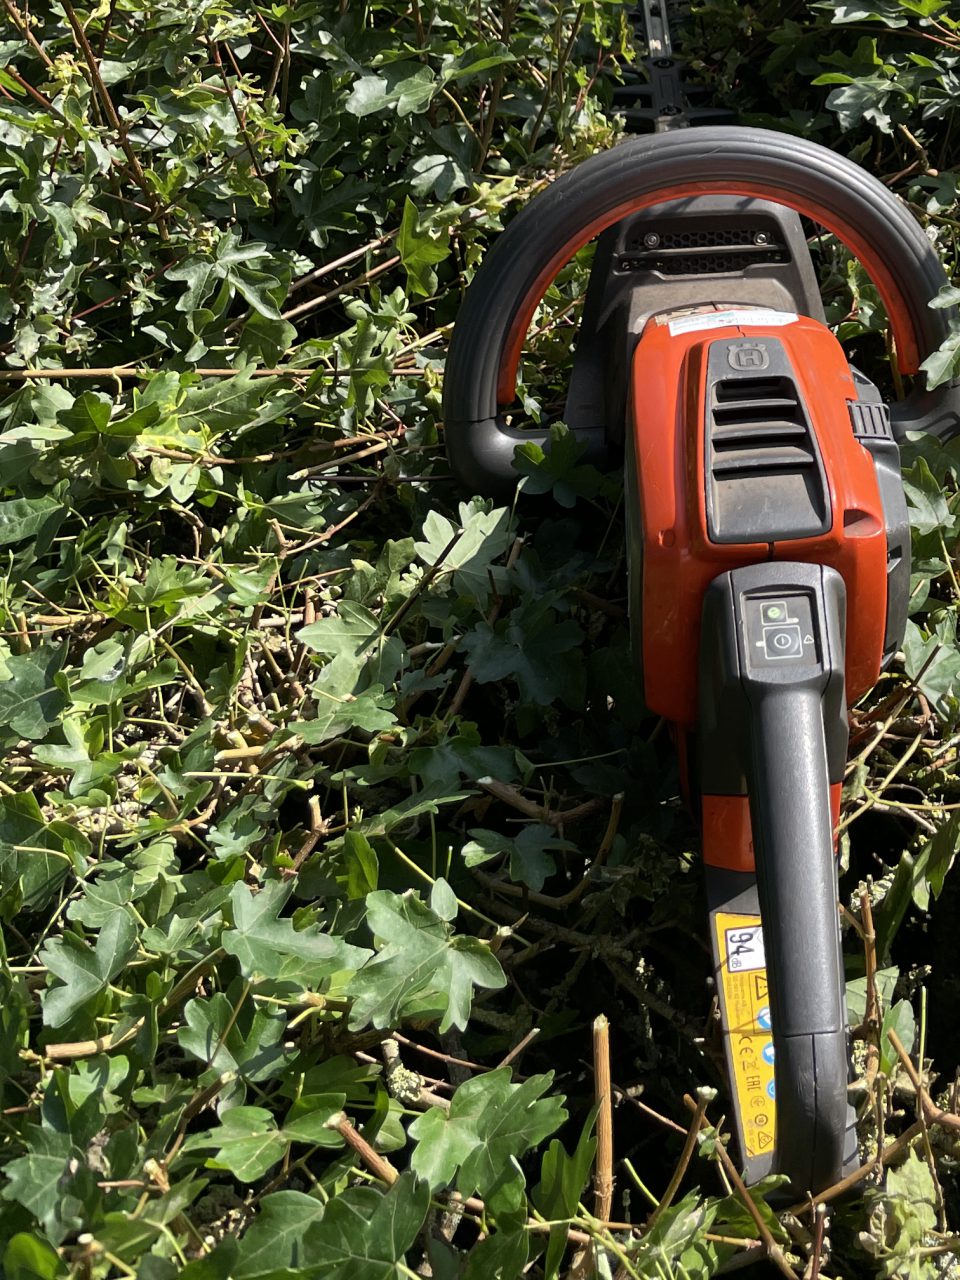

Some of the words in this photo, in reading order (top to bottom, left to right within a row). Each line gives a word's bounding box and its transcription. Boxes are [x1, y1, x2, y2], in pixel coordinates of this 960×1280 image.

[738, 350, 759, 366] H
[729, 932, 755, 956] 94
[731, 957, 742, 969] dB
